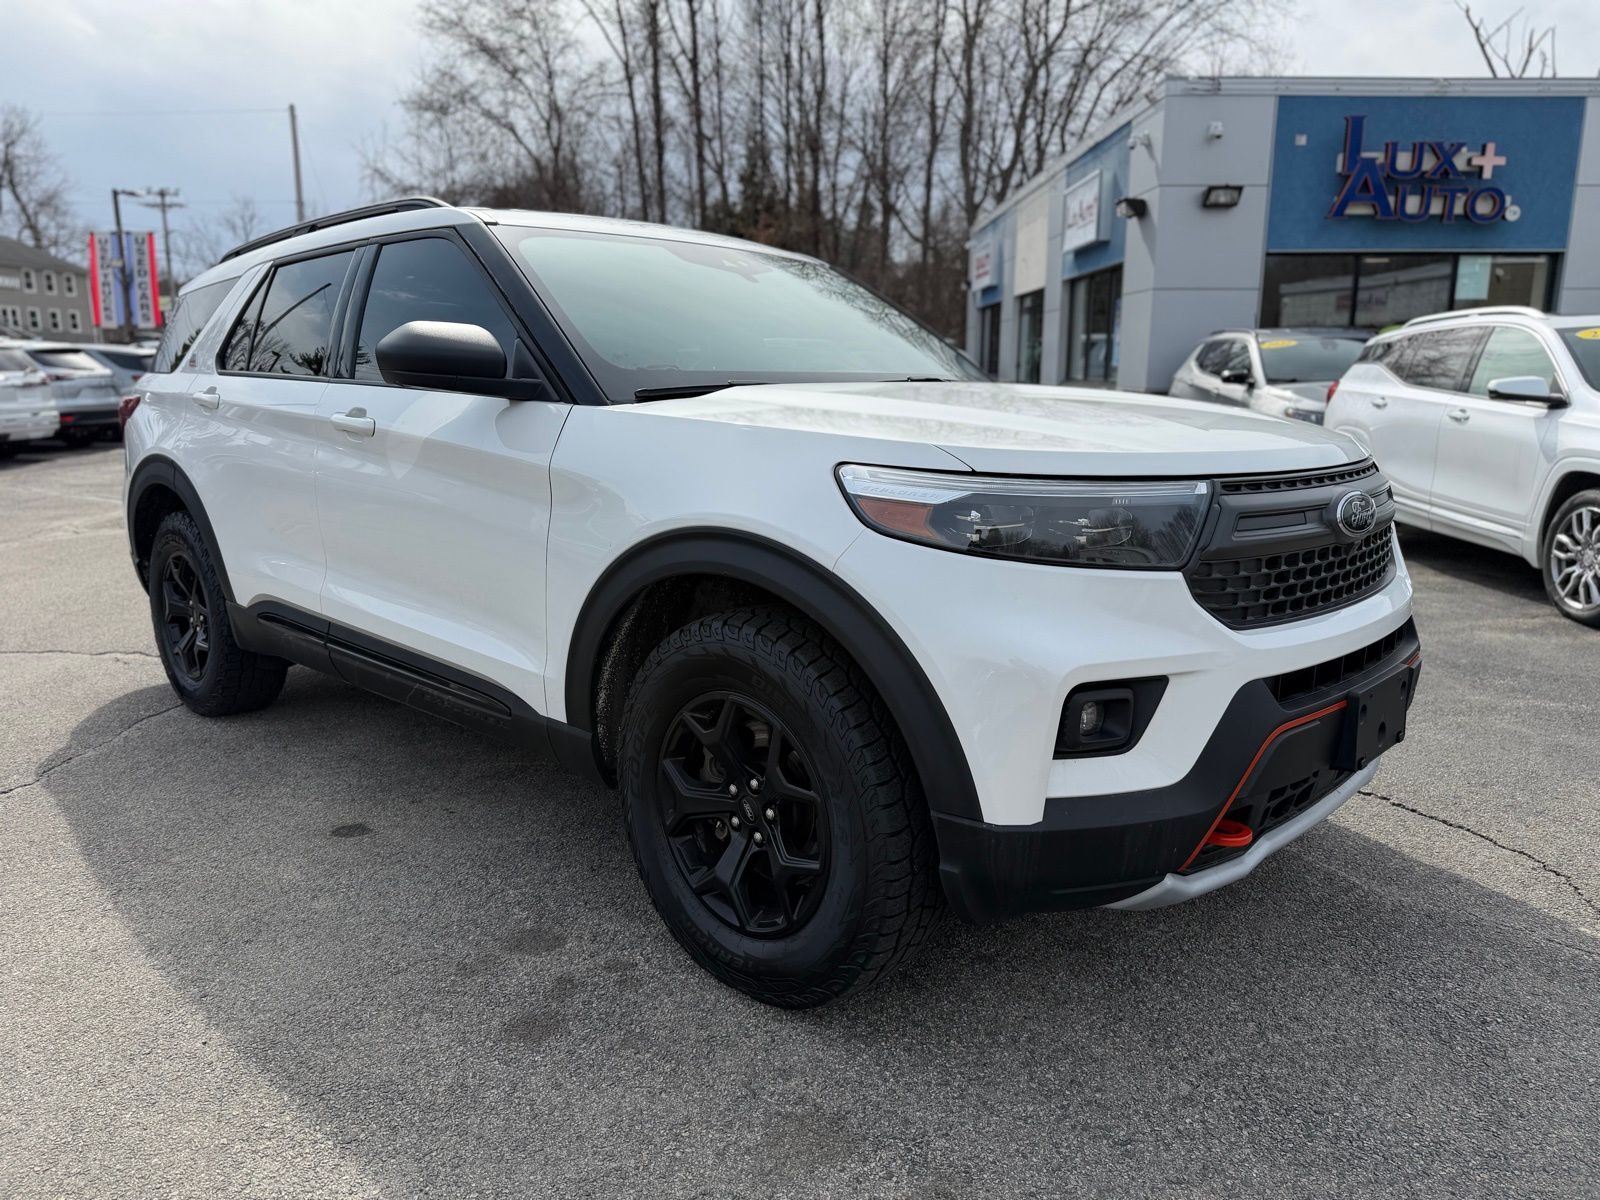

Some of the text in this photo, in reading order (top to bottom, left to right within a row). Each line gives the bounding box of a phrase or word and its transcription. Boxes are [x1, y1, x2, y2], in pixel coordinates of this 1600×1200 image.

[1326, 157, 1507, 225] AUTO
[134, 237, 151, 322] USED CARS
